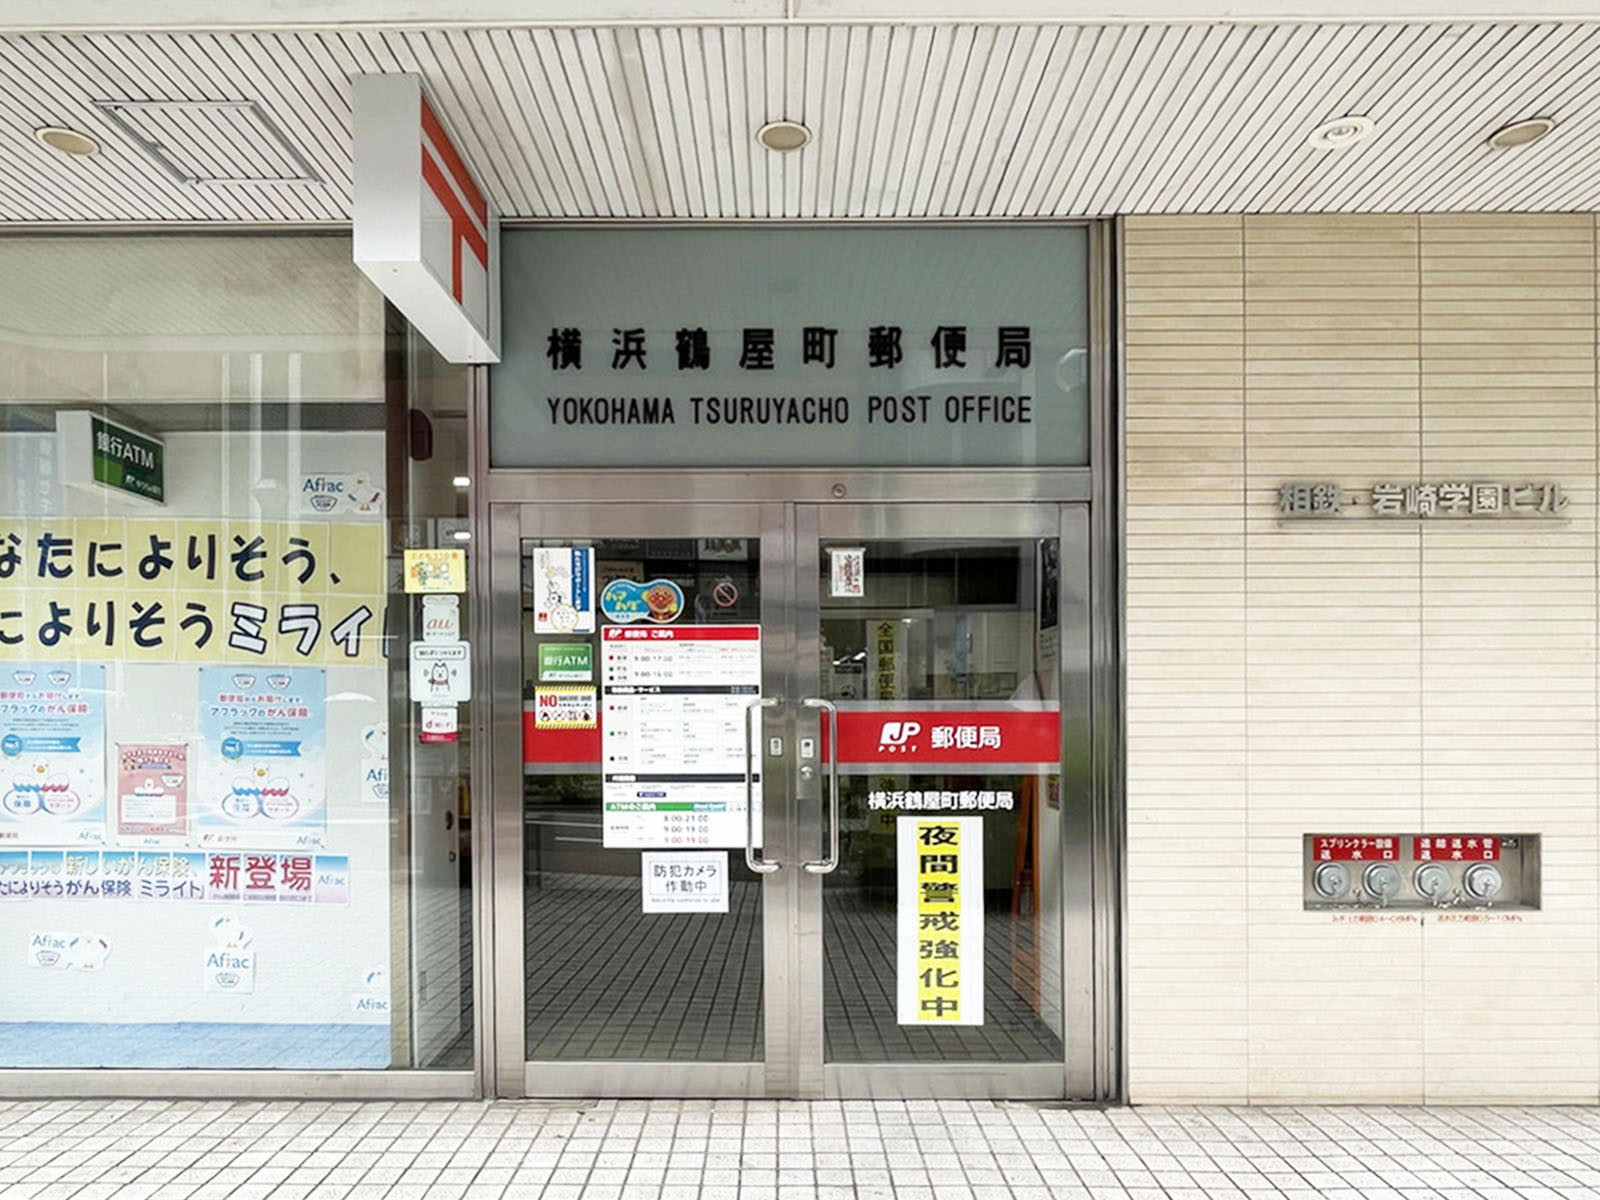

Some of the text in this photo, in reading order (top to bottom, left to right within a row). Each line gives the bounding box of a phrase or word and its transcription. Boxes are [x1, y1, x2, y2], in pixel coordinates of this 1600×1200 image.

[547, 327, 1032, 370] 横浜鶴屋町郵便局
[547, 397, 1033, 425] YOKOHAMA TSURUYACHO POST OFFICE
[96, 431, 154, 470] 銀行ATM
[1279, 482, 1568, 515] 相鉄・岩崎学園ビル
[0, 601, 389, 657] によりそうミライ
[426, 619, 454, 630] au
[539, 695, 558, 707] NO
[877, 745, 918, 753] POST
[930, 726, 1001, 749] 郵便局
[868, 791, 1014, 810] 横浜鶴屋町郵便局
[209, 856, 313, 892] 新登場
[654, 864, 717, 878] 防犯カメラ
[665, 880, 707, 893] 作動中
[919, 826, 960, 1017] 夜間警戒強化中
